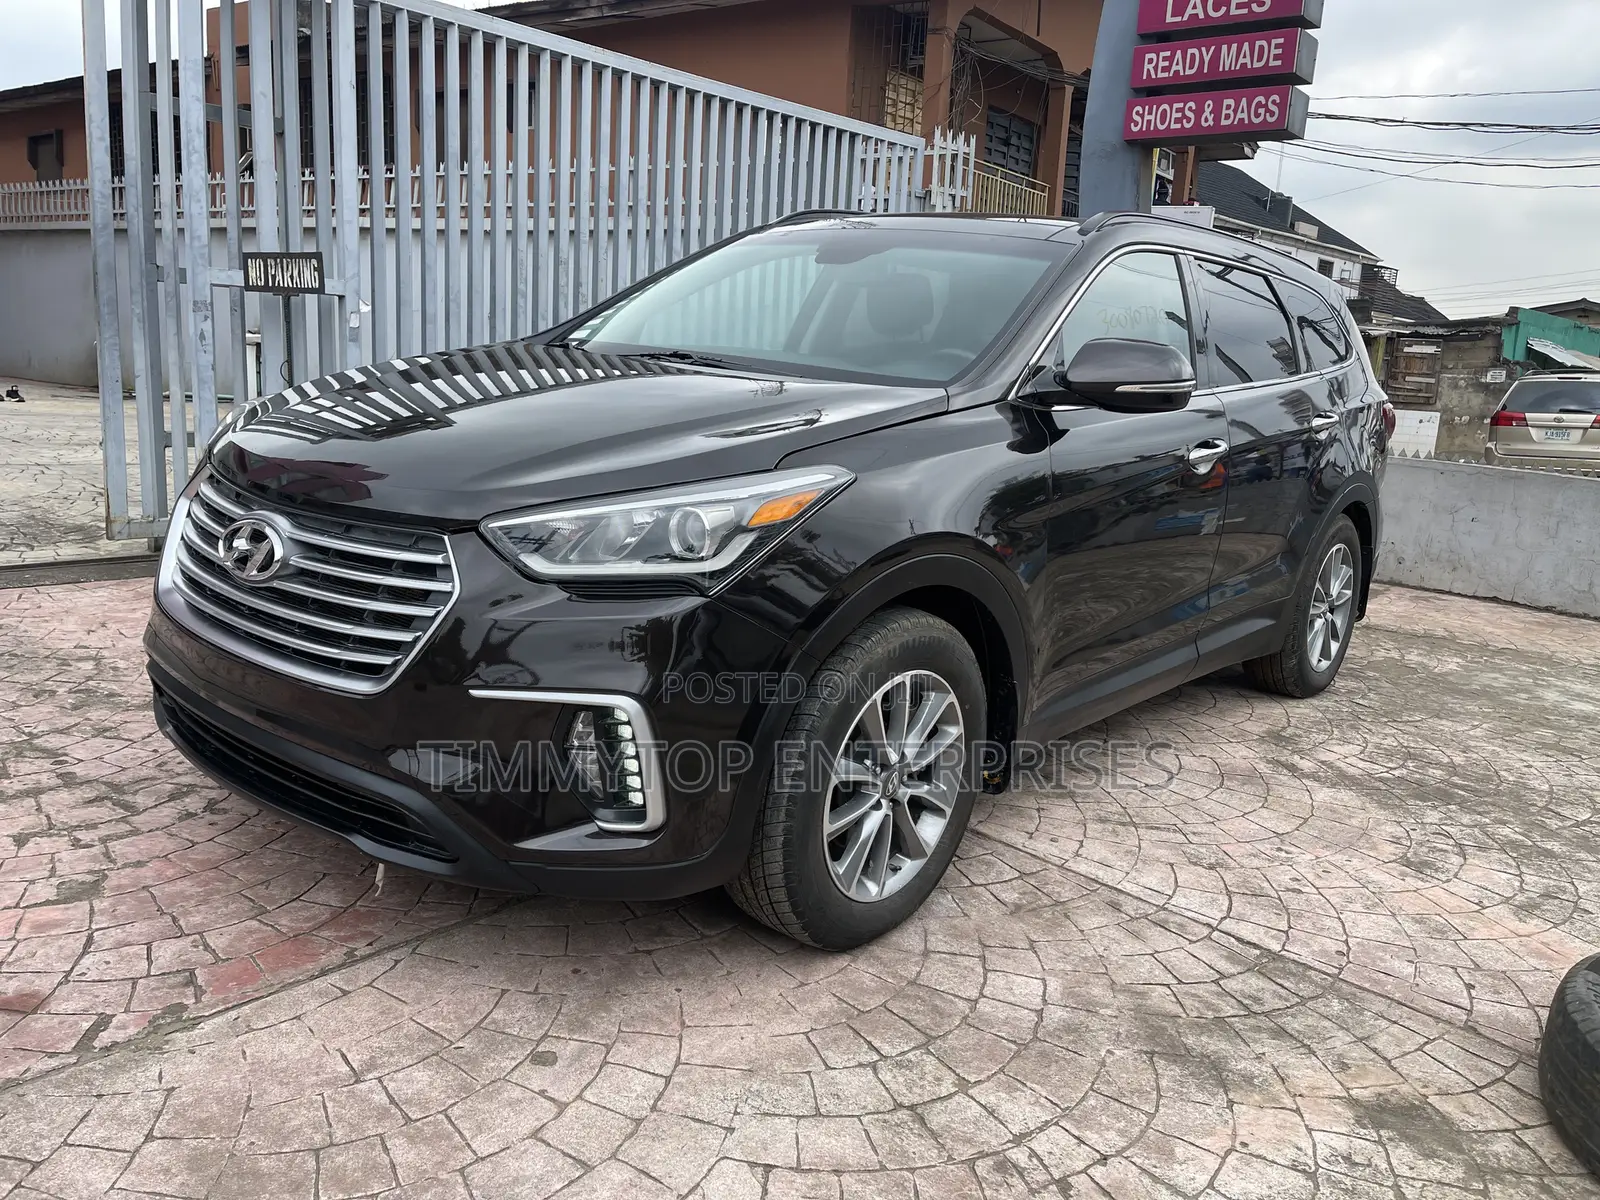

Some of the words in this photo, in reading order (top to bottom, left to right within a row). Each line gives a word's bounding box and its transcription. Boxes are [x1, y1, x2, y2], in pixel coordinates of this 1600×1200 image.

[1143, 45, 1215, 80] READY
[1219, 37, 1285, 72] MADE
[1130, 100, 1196, 132] SHOES
[1201, 99, 1215, 128] &
[1220, 94, 1280, 126] BAGS
[247, 258, 264, 286] NO
[267, 258, 319, 288] PARKING
